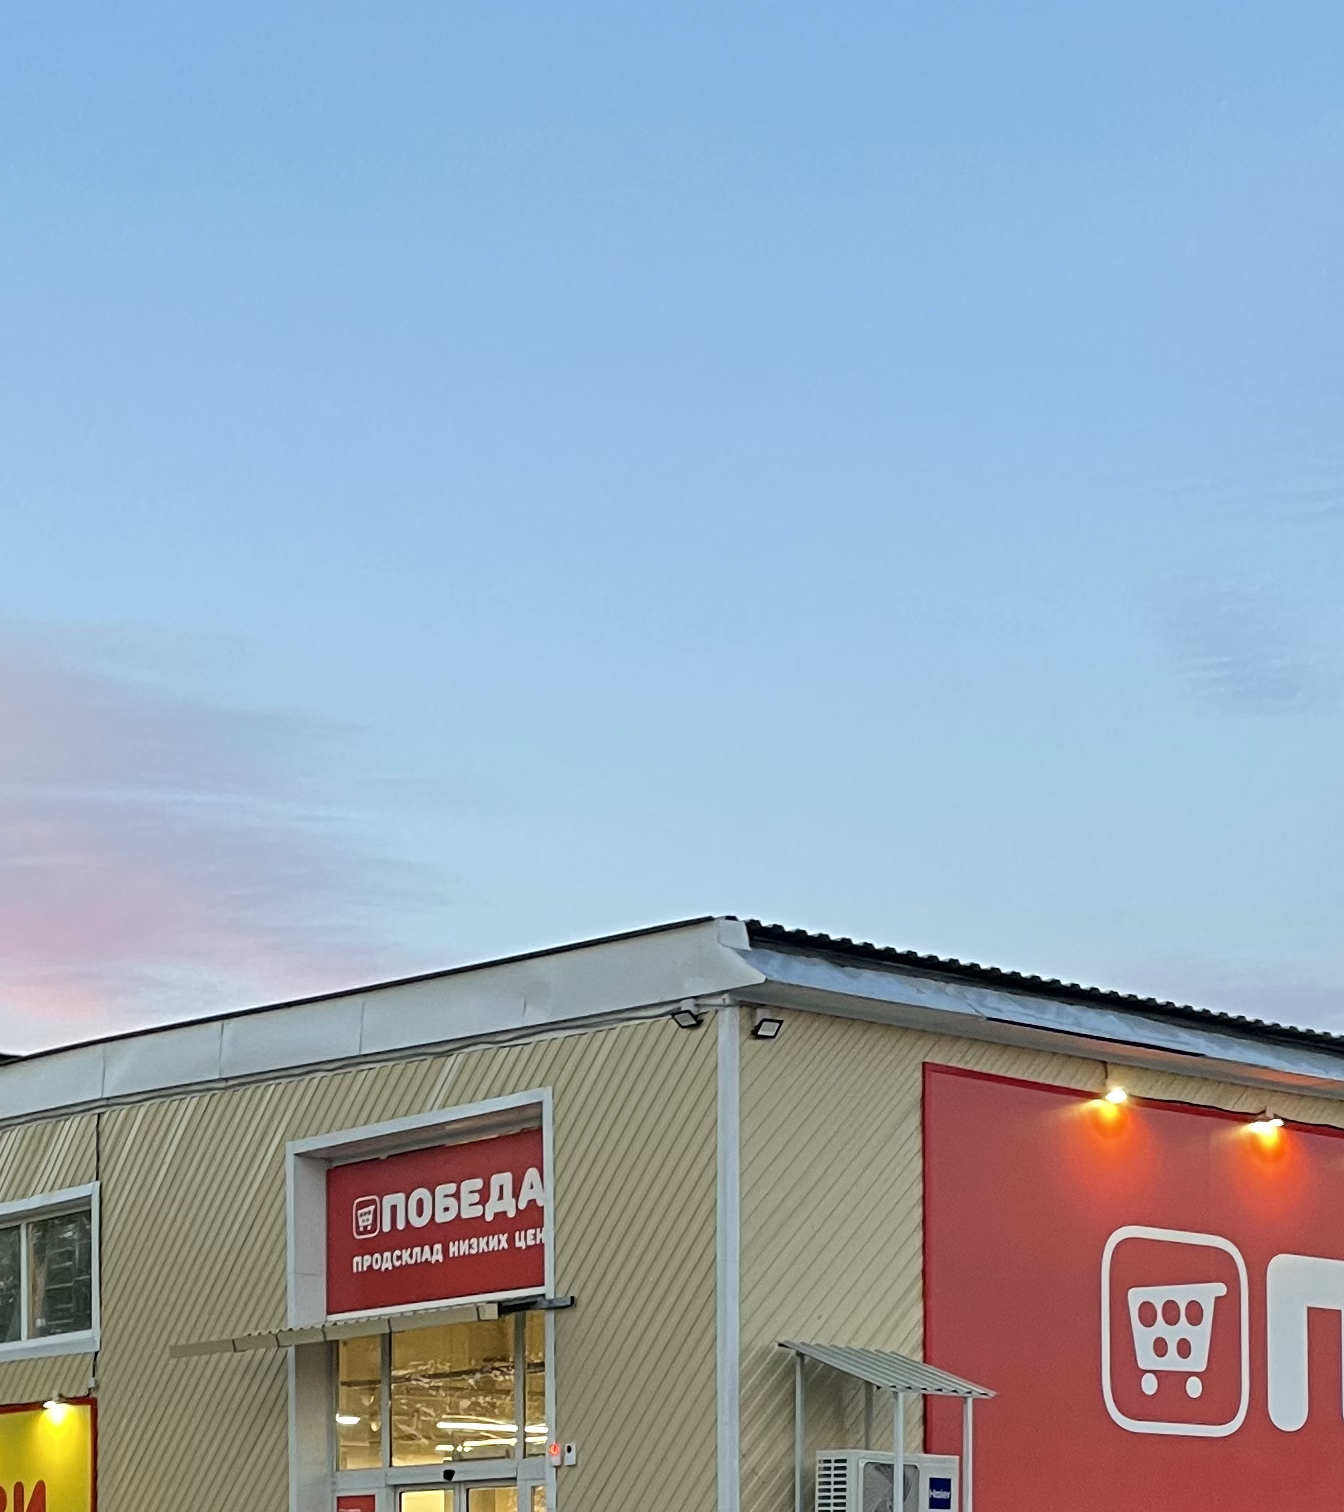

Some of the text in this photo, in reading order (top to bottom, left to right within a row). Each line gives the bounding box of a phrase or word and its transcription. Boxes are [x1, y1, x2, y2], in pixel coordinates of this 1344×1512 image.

[382, 1168, 545, 1233] ПОБЕДА
[353, 1243, 443, 1273] ПРОДСКЛАД
[449, 1233, 508, 1258] НИЗКИХ
